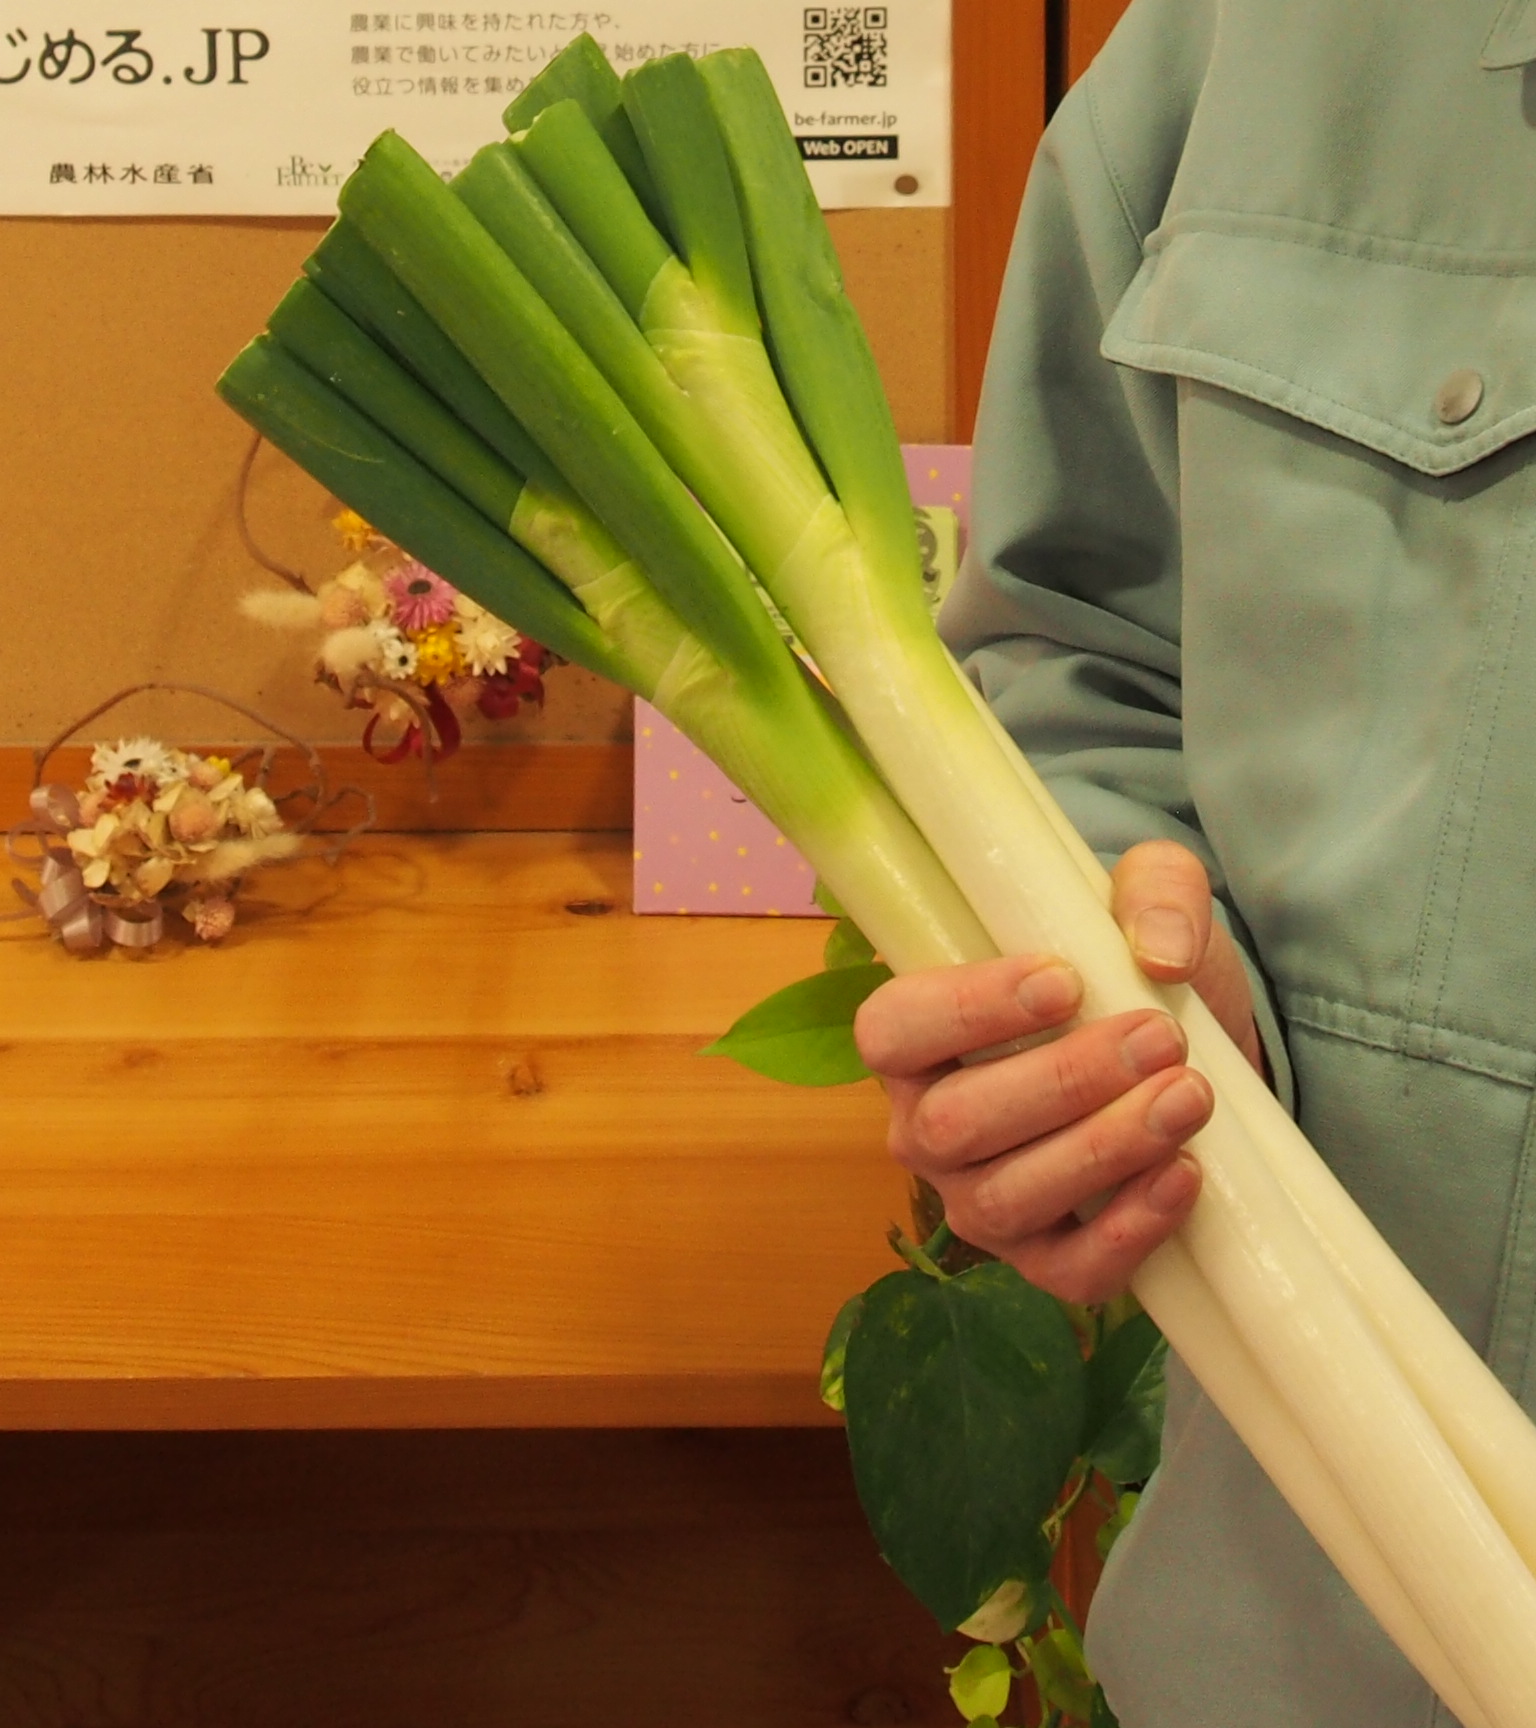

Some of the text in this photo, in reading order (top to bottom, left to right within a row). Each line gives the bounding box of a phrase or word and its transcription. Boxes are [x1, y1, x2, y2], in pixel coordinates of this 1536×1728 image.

[794, 111, 898, 129] be-farmer.jp
[803, 138, 890, 157] Web OPEN
[49, 162, 215, 185] 農林水産省
